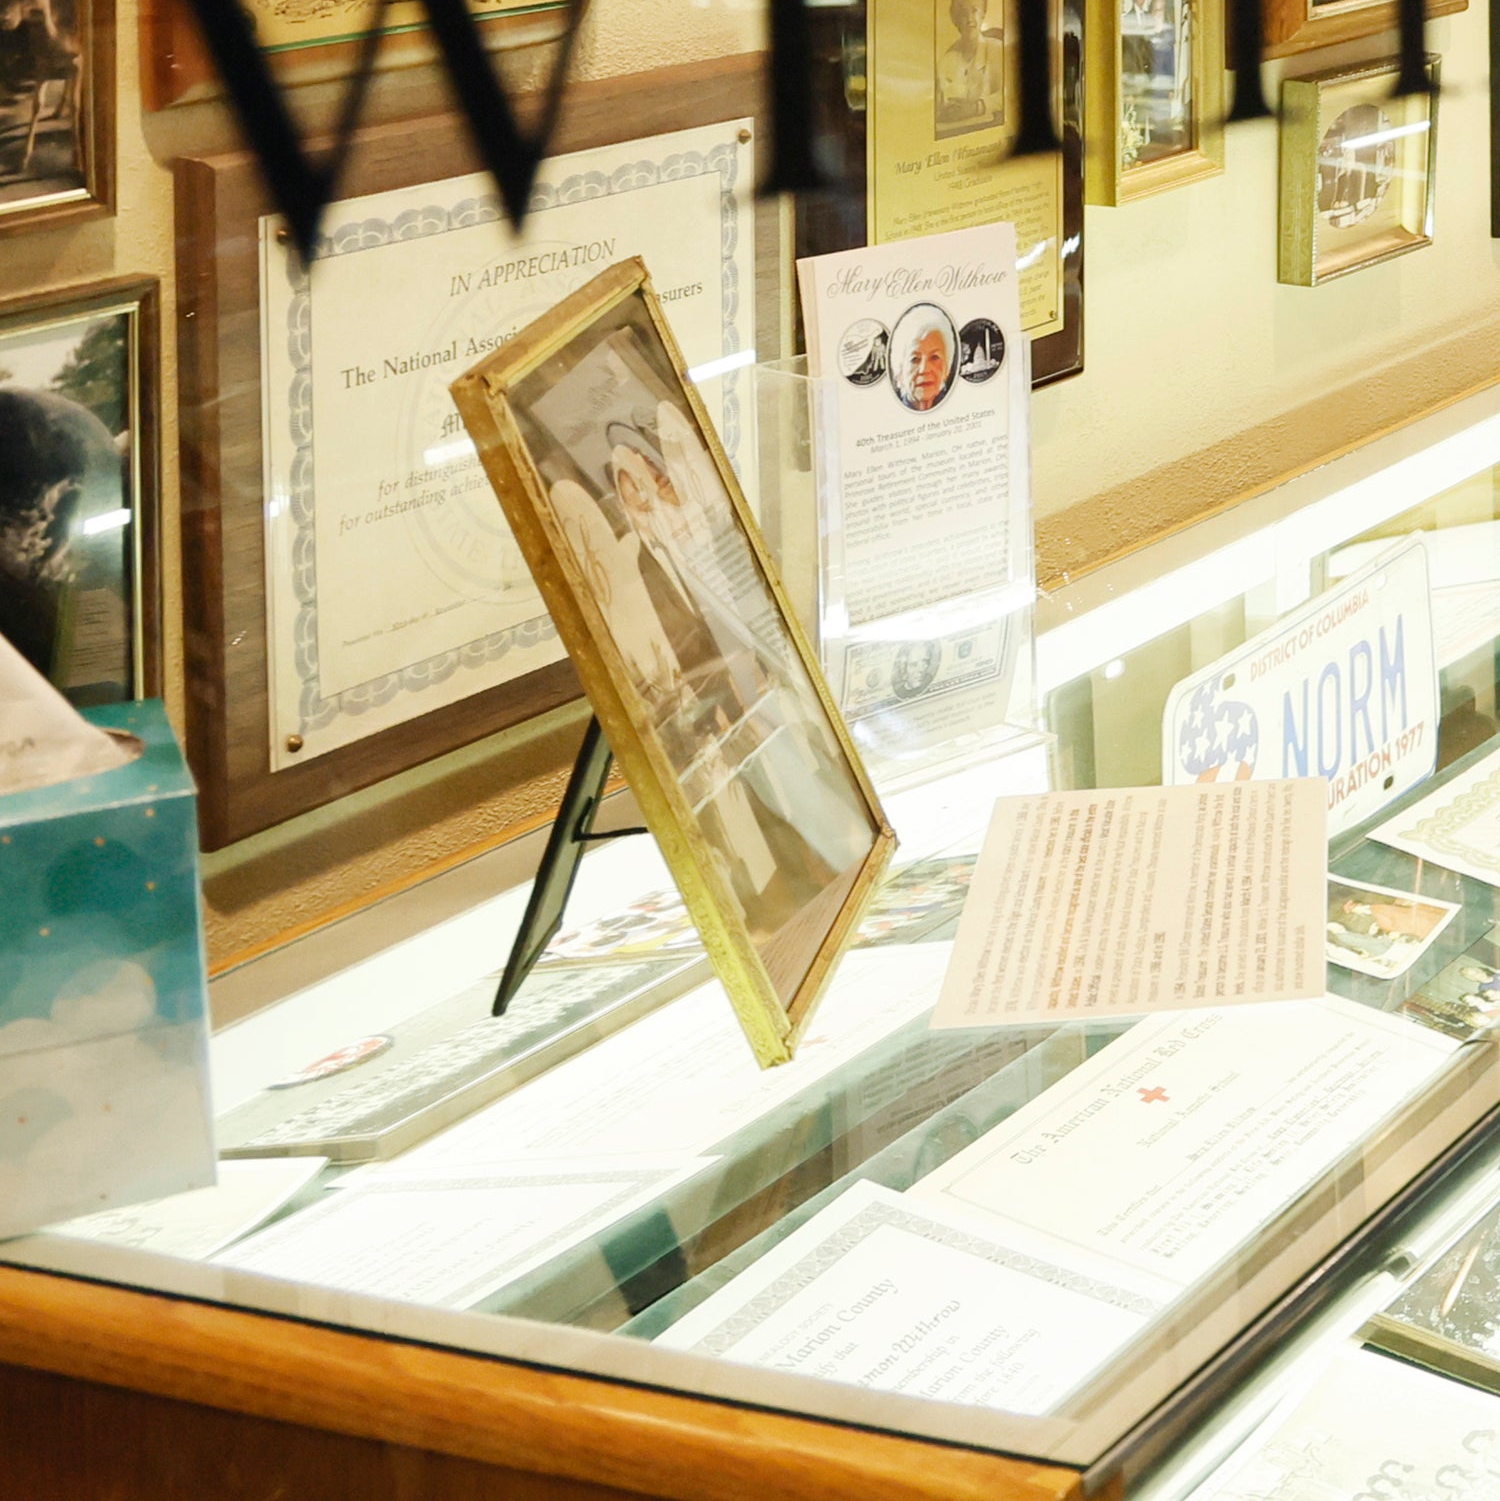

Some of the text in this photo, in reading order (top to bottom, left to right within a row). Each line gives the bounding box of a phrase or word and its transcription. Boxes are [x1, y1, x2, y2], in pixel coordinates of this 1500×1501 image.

[450, 238, 616, 297] IN APPRECIATION
[827, 264, 1007, 300] Mary Ellen Withrow
[341, 282, 703, 389] The National Associ asurers
[856, 409, 995, 447] 40th Treasurer of the United States
[340, 489, 446, 535] for outstanding
[377, 480, 400, 501] for
[404, 456, 483, 490] distinguish
[1250, 589, 1370, 681] DISTRICT OF COLUMBIA
[1282, 613, 1407, 781] NORM
[1328, 722, 1424, 810] URATION 1977
[1010, 1012, 1223, 1164] The American National Red Cross
[775, 1318, 840, 1372] Marion
[838, 1277, 899, 1323] County
[893, 1299, 961, 1355] Withrow
